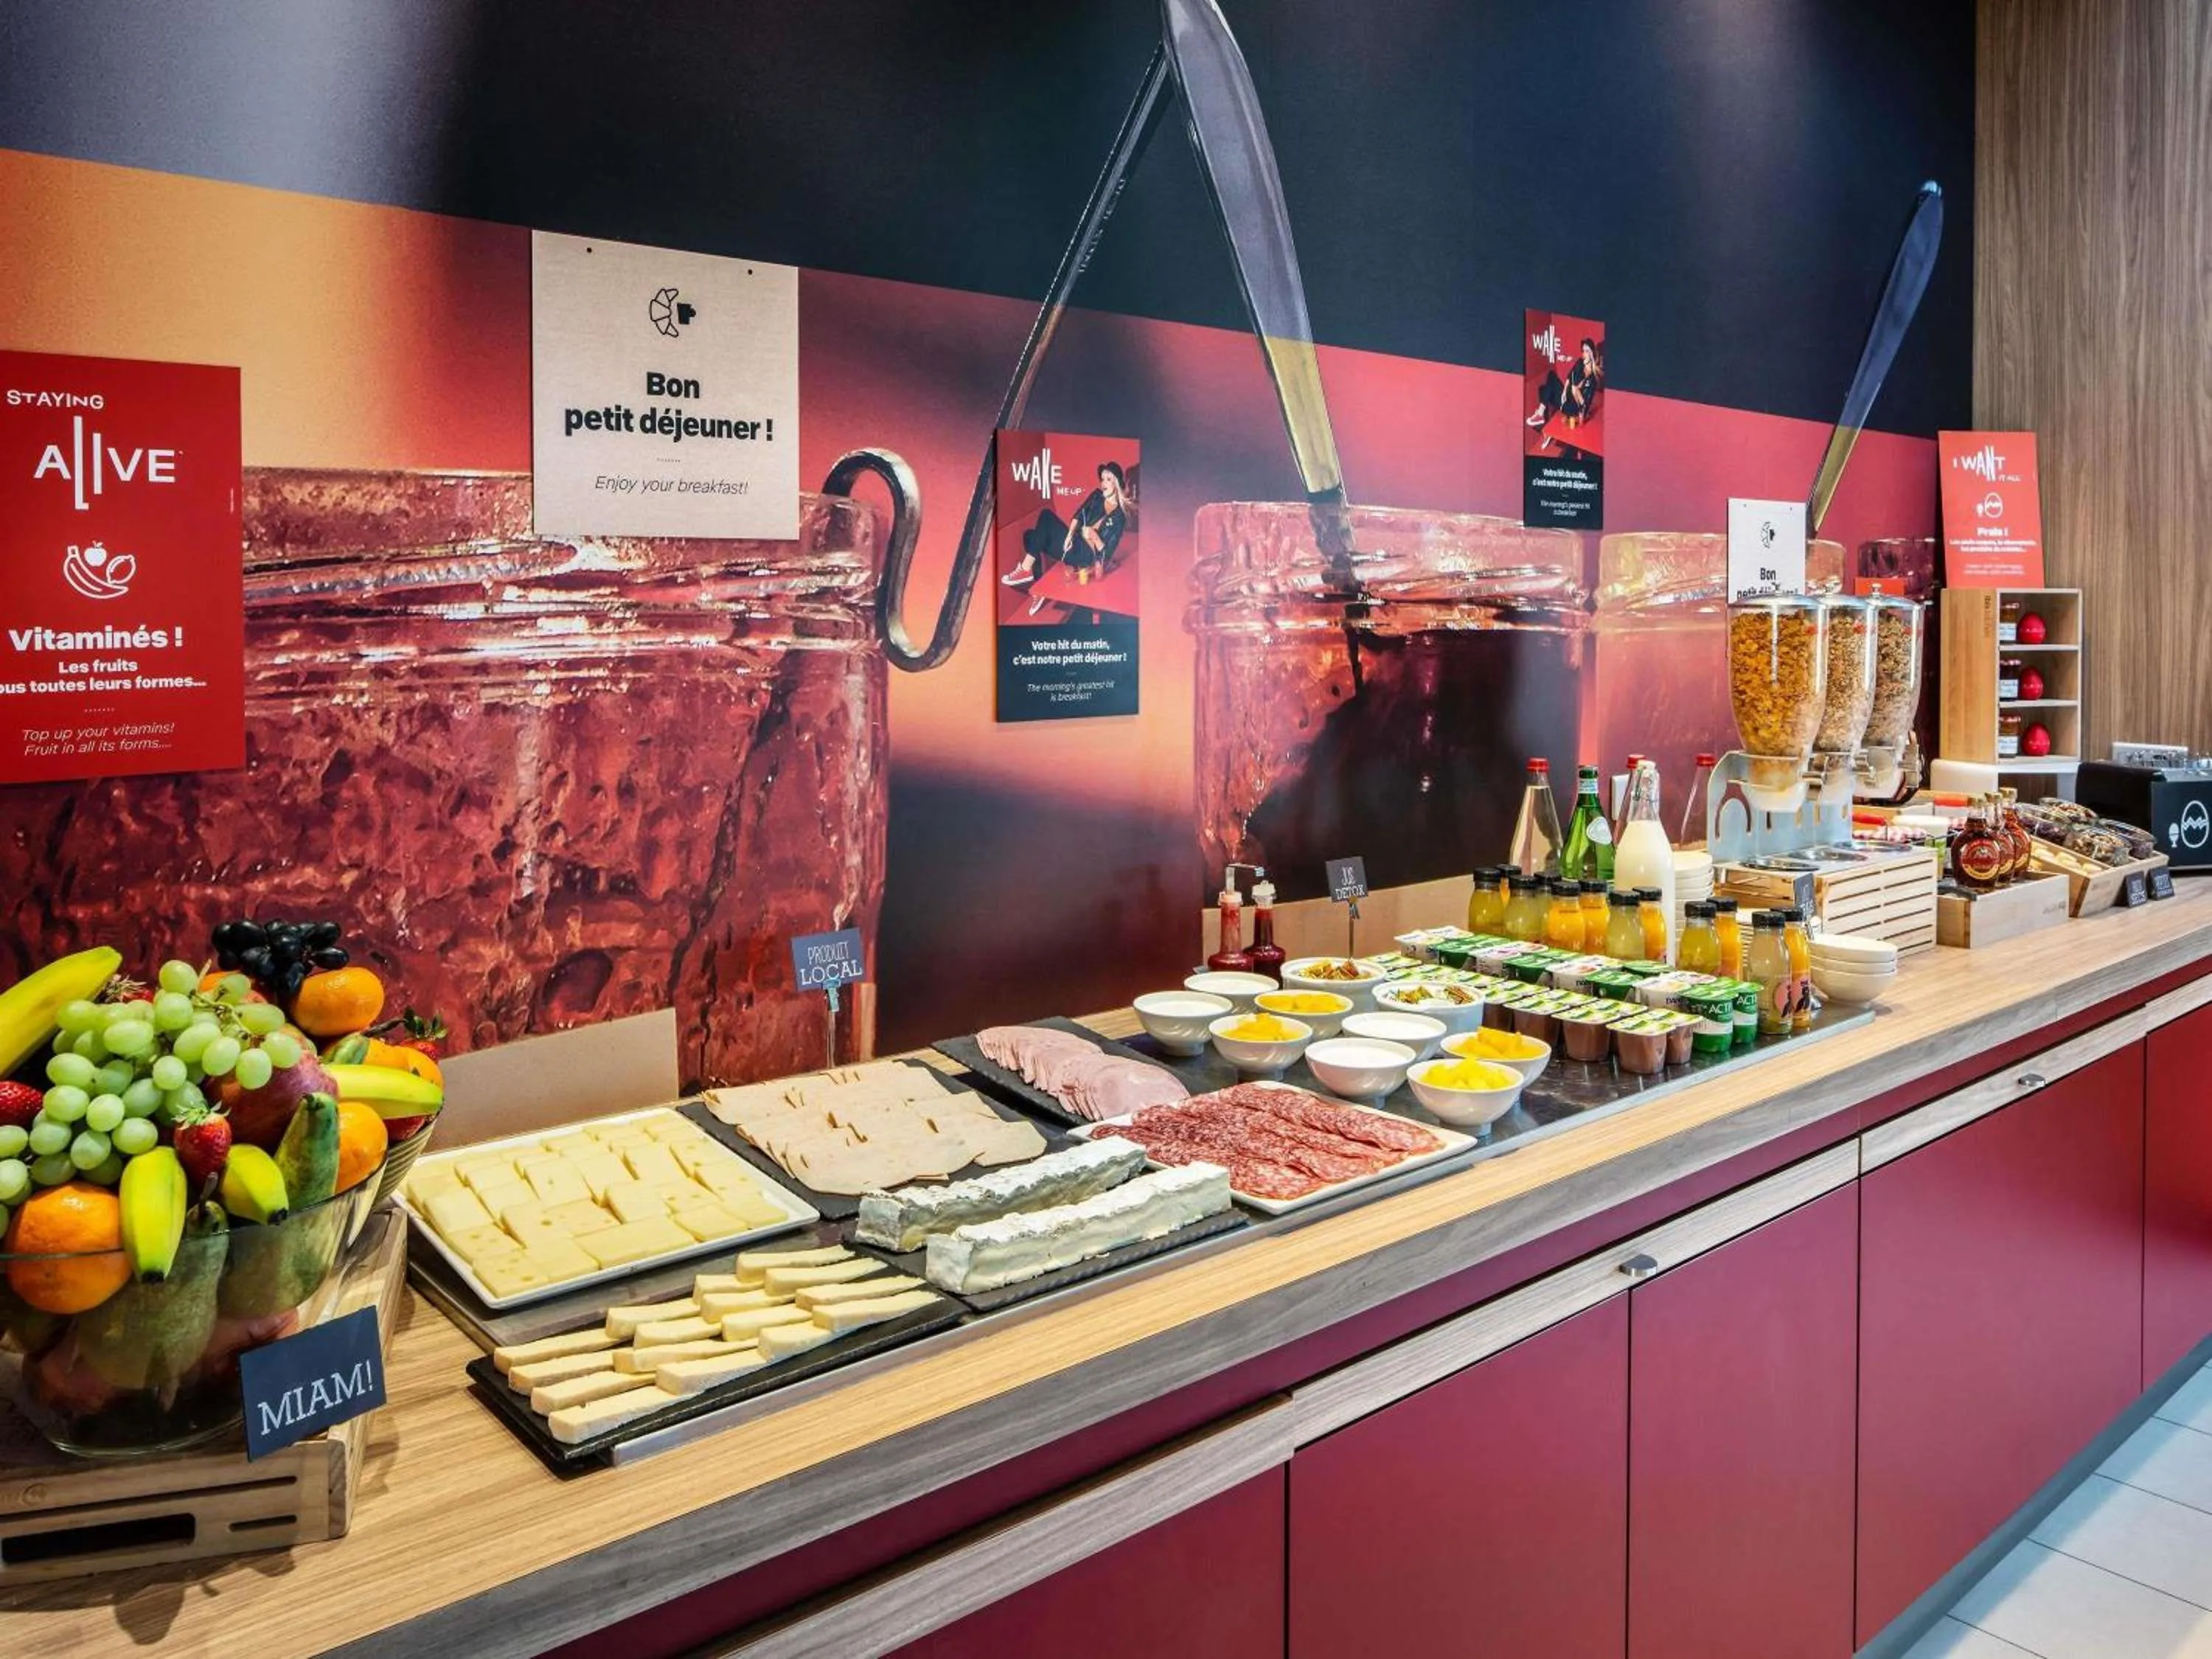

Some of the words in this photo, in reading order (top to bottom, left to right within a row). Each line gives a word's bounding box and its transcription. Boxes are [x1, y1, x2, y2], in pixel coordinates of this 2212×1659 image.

[647, 371, 700, 399] Bon
[7, 389, 104, 409] STAYING
[565, 404, 634, 437] petit
[639, 406, 761, 442] déjeuner
[766, 418, 773, 442] !
[34, 415, 175, 510] ALIVE
[1961, 445, 2006, 481] WANT
[1012, 448, 1062, 498] WAKE
[595, 476, 639, 494] Enjoy
[641, 480, 675, 495] your
[678, 479, 749, 495] breakfast!
[9, 625, 168, 651] Vitaminés
[175, 626, 183, 647] !
[1032, 641, 1056, 651] Votre
[1057, 640, 1069, 650] hit
[1071, 639, 1082, 650] du
[59, 661, 89, 674] Les
[93, 658, 138, 672] fruits
[1062, 653, 1083, 667] petit
[29, 680, 86, 693] toutes
[89, 677, 132, 691] leurs
[22, 728, 49, 742] Top
[54, 729, 73, 742] up
[76, 727, 108, 741] your
[113, 722, 175, 737] vitamins!
[24, 742, 59, 756] Fruit
[61, 742, 74, 754] in
[77, 740, 96, 753] all
[98, 740, 116, 752] its
[1335, 884, 1366, 900] DETOX
[800, 959, 862, 985] LOCAL
[257, 1360, 374, 1436] MIAM!
